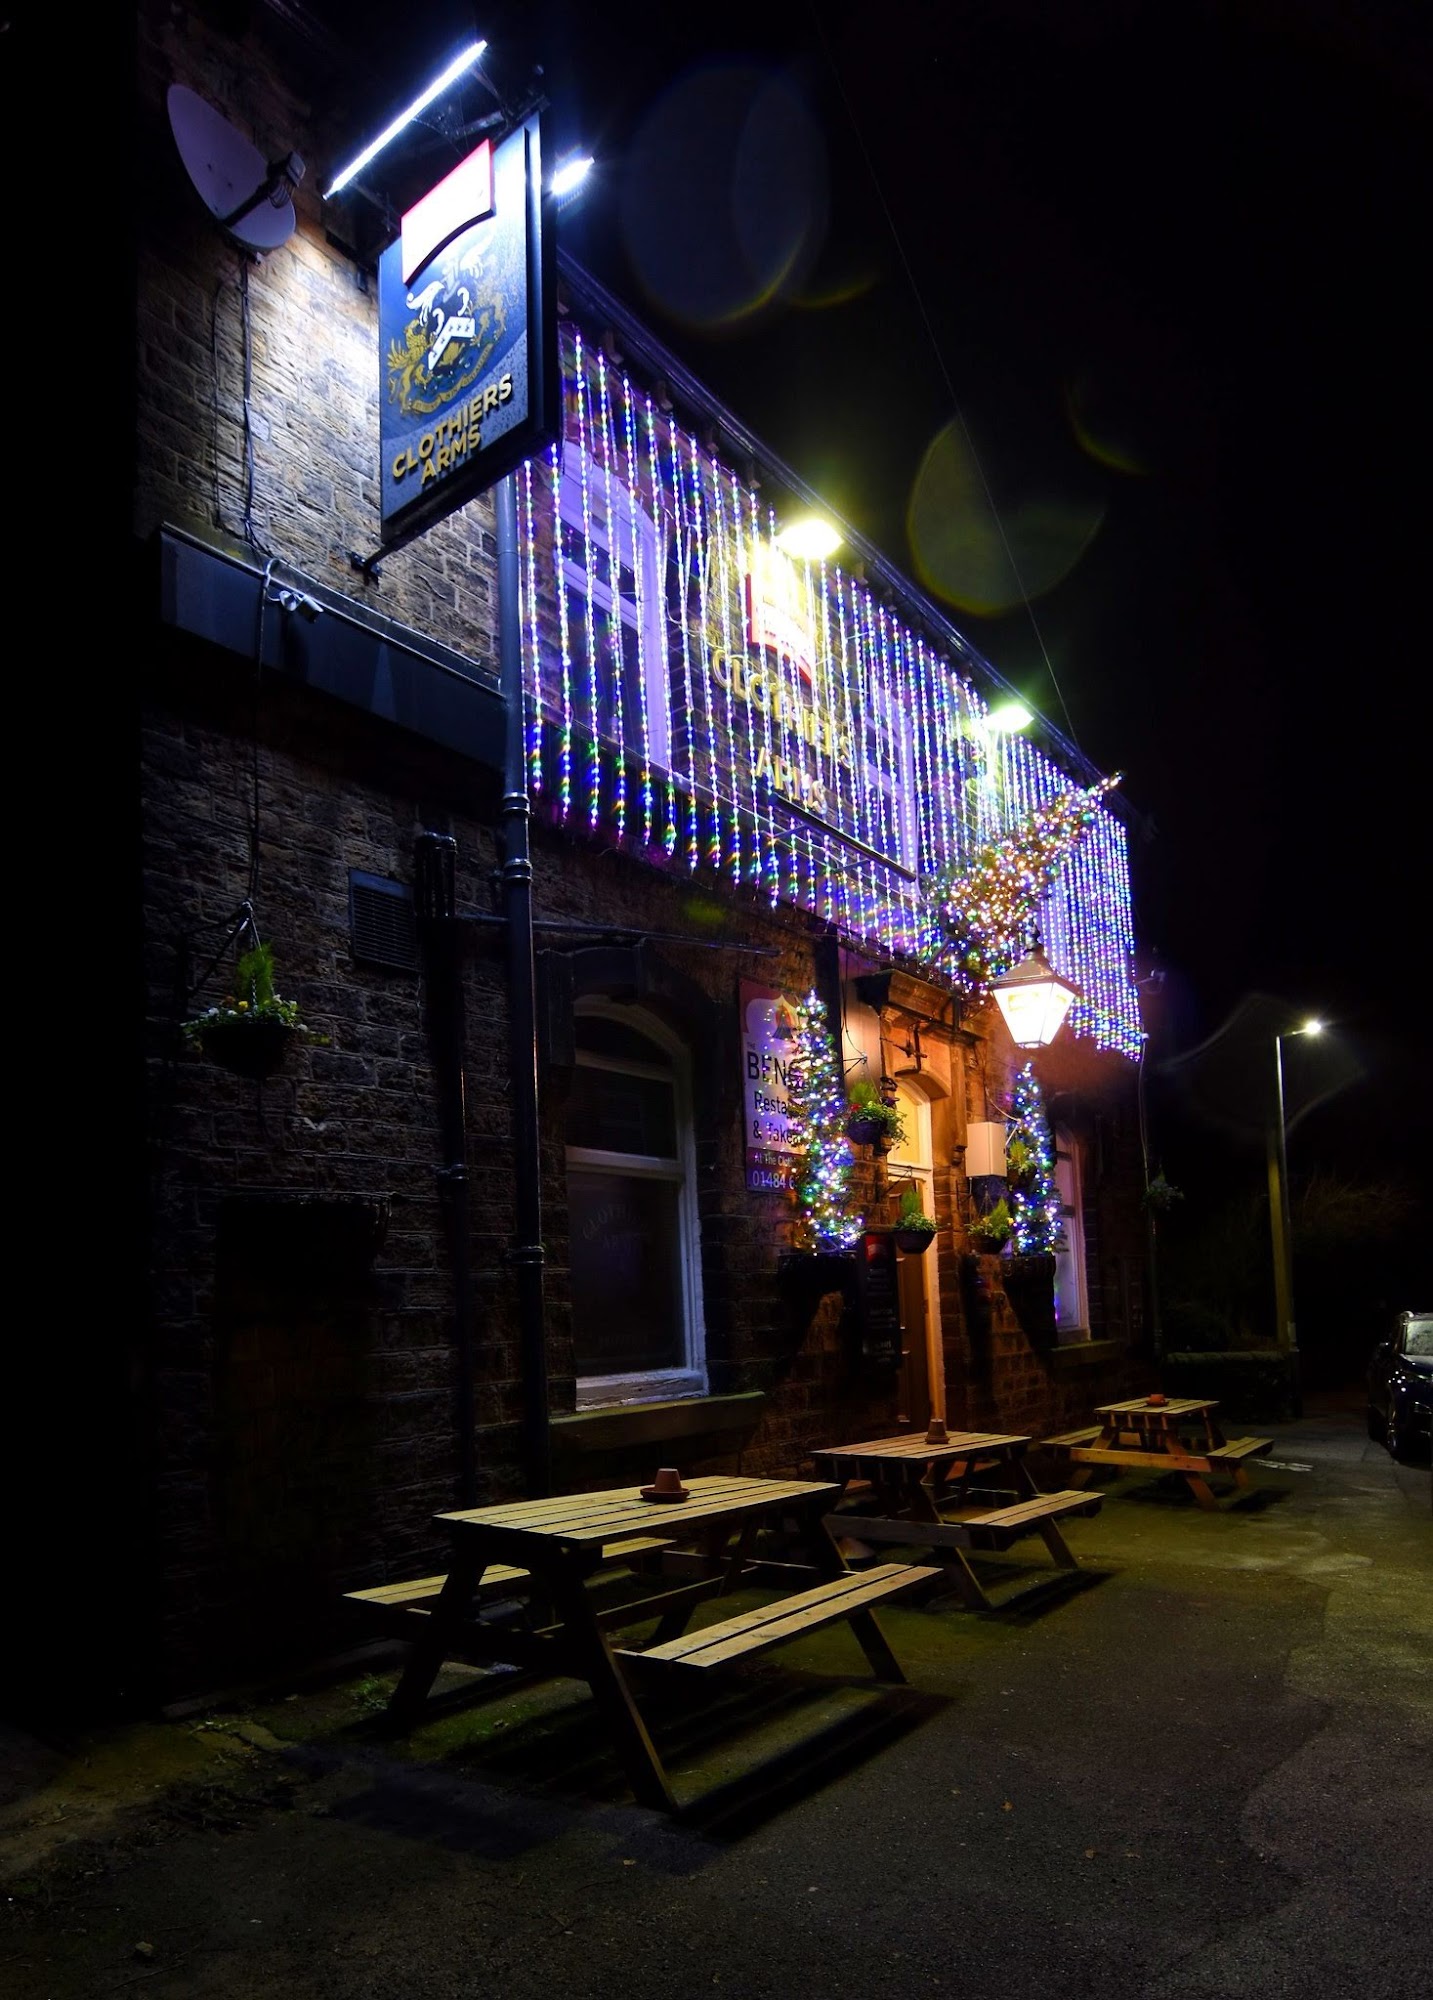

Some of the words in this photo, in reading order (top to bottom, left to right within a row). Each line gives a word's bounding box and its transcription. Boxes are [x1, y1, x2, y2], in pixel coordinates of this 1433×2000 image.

[392, 373, 513, 479] CLOTHIERS
[420, 423, 482, 485] ARMS
[754, 1090, 792, 1119] Resta
[753, 1119, 762, 1140] &
[752, 1170, 787, 1189] 01484
